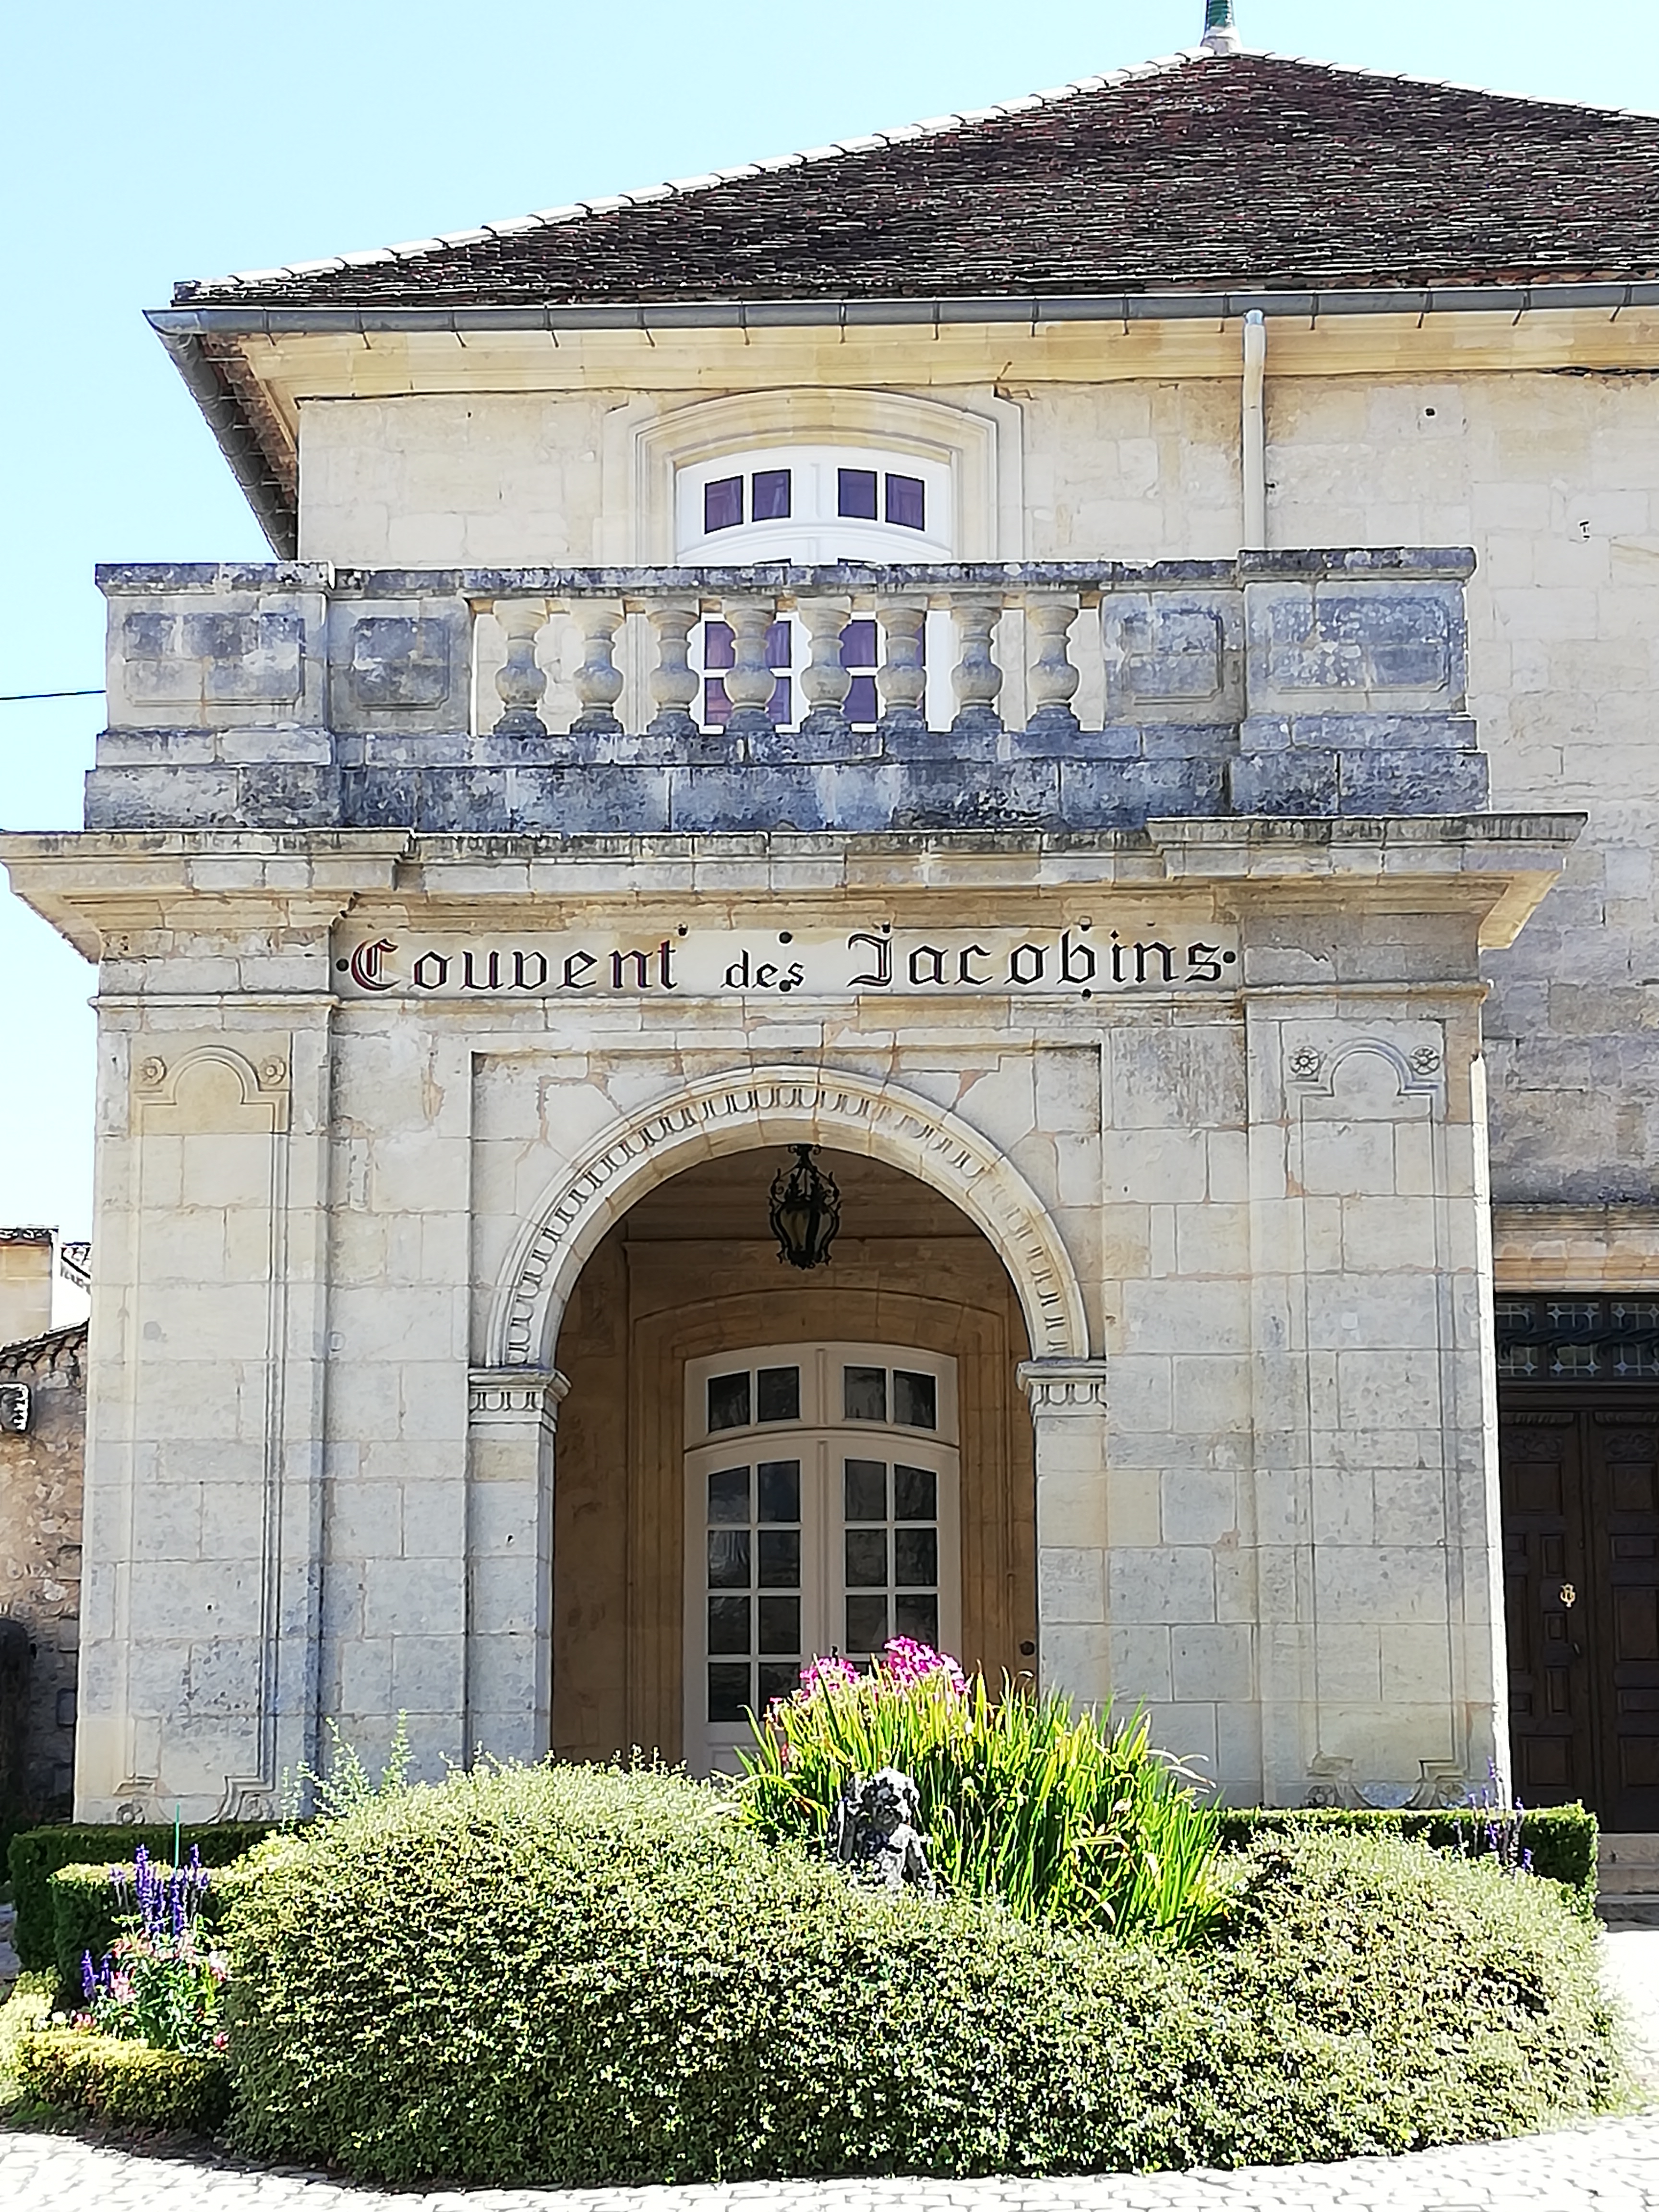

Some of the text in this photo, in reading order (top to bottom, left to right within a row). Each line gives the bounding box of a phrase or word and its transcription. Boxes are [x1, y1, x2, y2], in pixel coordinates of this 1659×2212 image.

[351, 930, 1221, 990] Couvent des Jacobins
